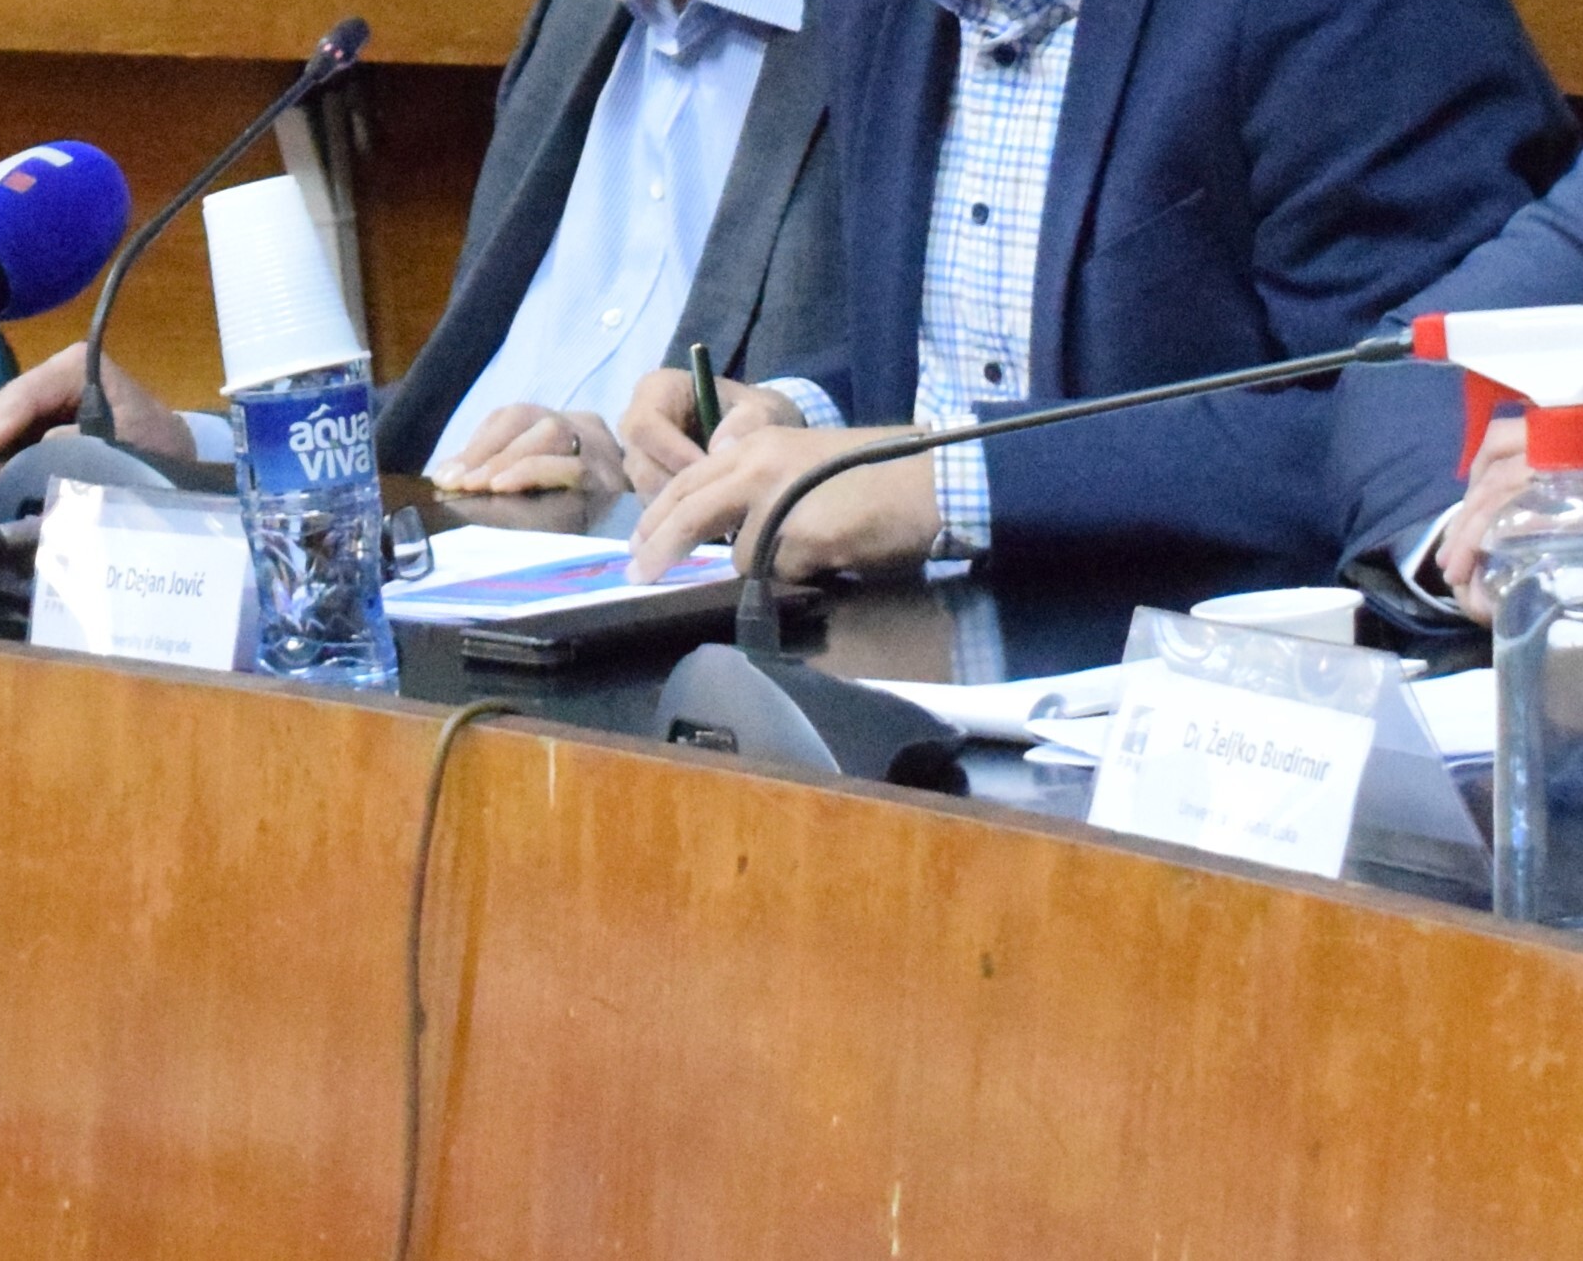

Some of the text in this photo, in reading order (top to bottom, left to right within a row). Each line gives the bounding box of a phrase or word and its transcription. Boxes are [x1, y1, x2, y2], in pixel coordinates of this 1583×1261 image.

[289, 404, 371, 452] aqua
[298, 442, 371, 482] viva
[106, 565, 206, 598] Dr Dejan Jović
[1182, 718, 1333, 783] Dr Željko Budimir
